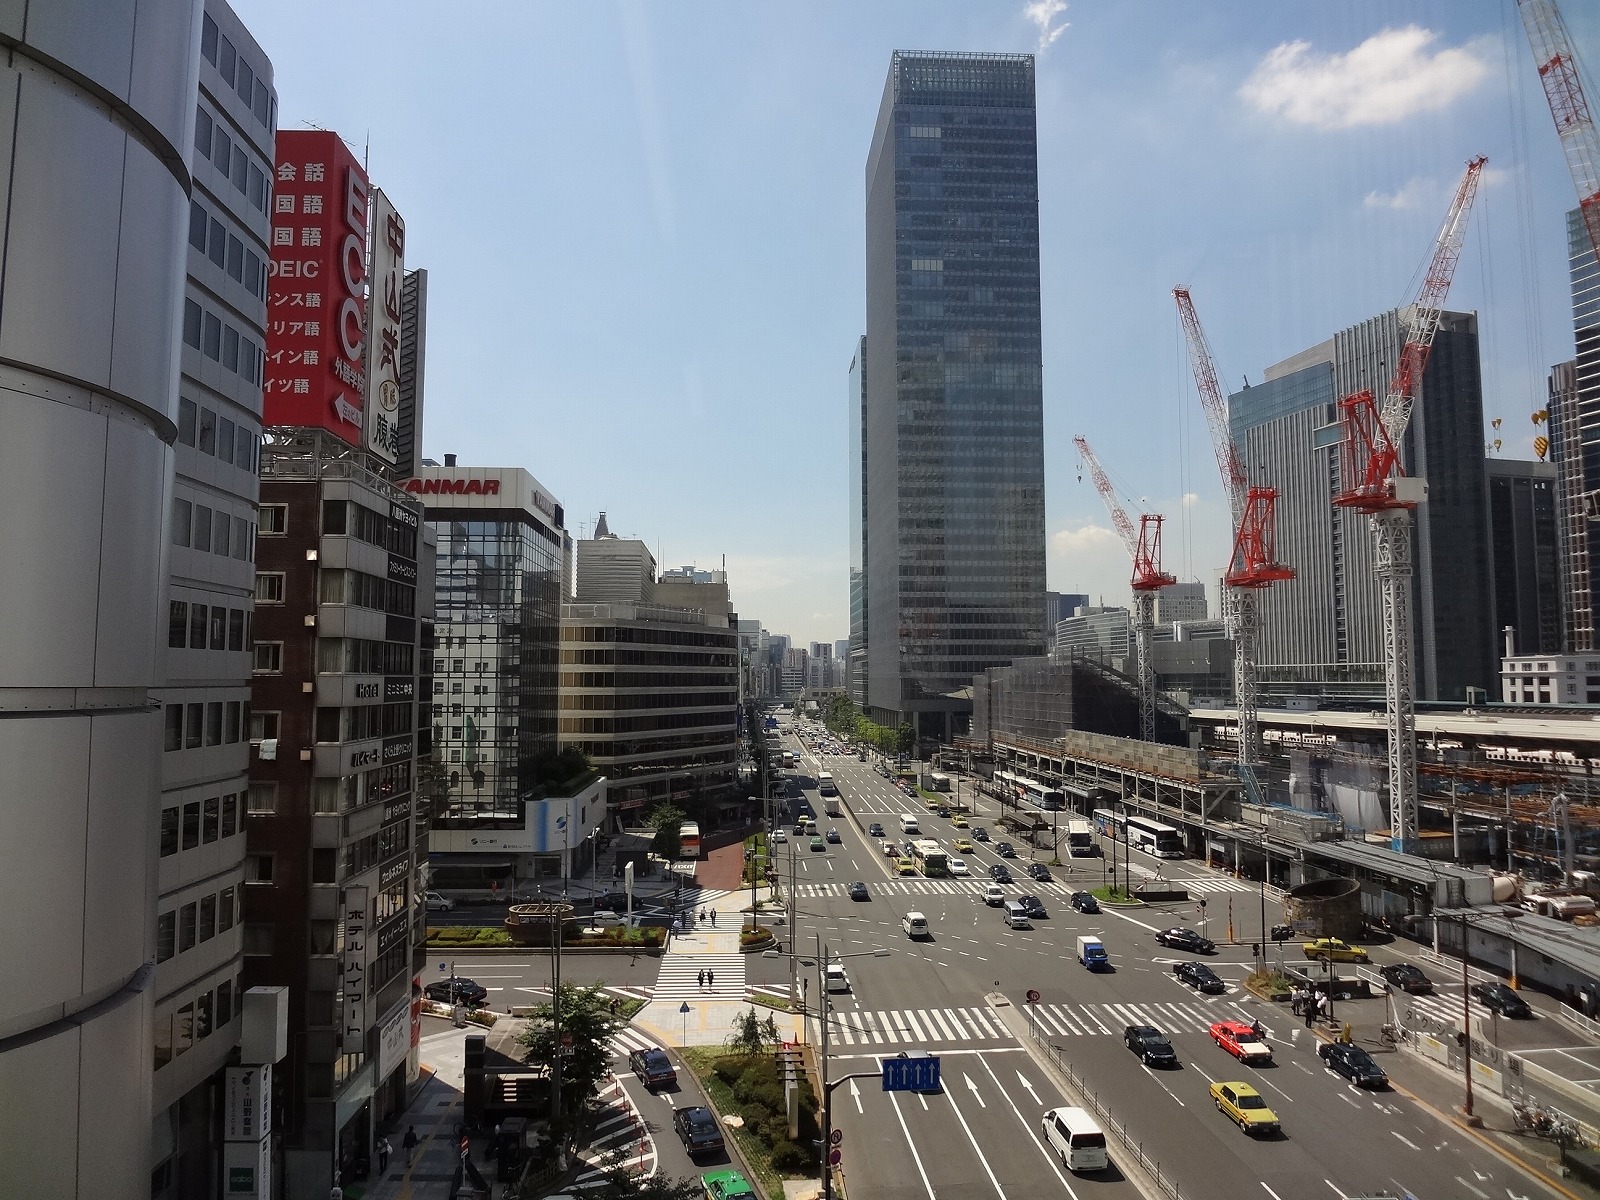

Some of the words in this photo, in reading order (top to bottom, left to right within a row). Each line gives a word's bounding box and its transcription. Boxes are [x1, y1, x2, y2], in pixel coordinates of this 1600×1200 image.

[277, 162, 325, 182] 会話
[275, 194, 323, 214] 国語
[273, 226, 322, 247] 国語
[340, 165, 367, 362] ECC
[346, 909, 365, 1036] ホテルハイマート
